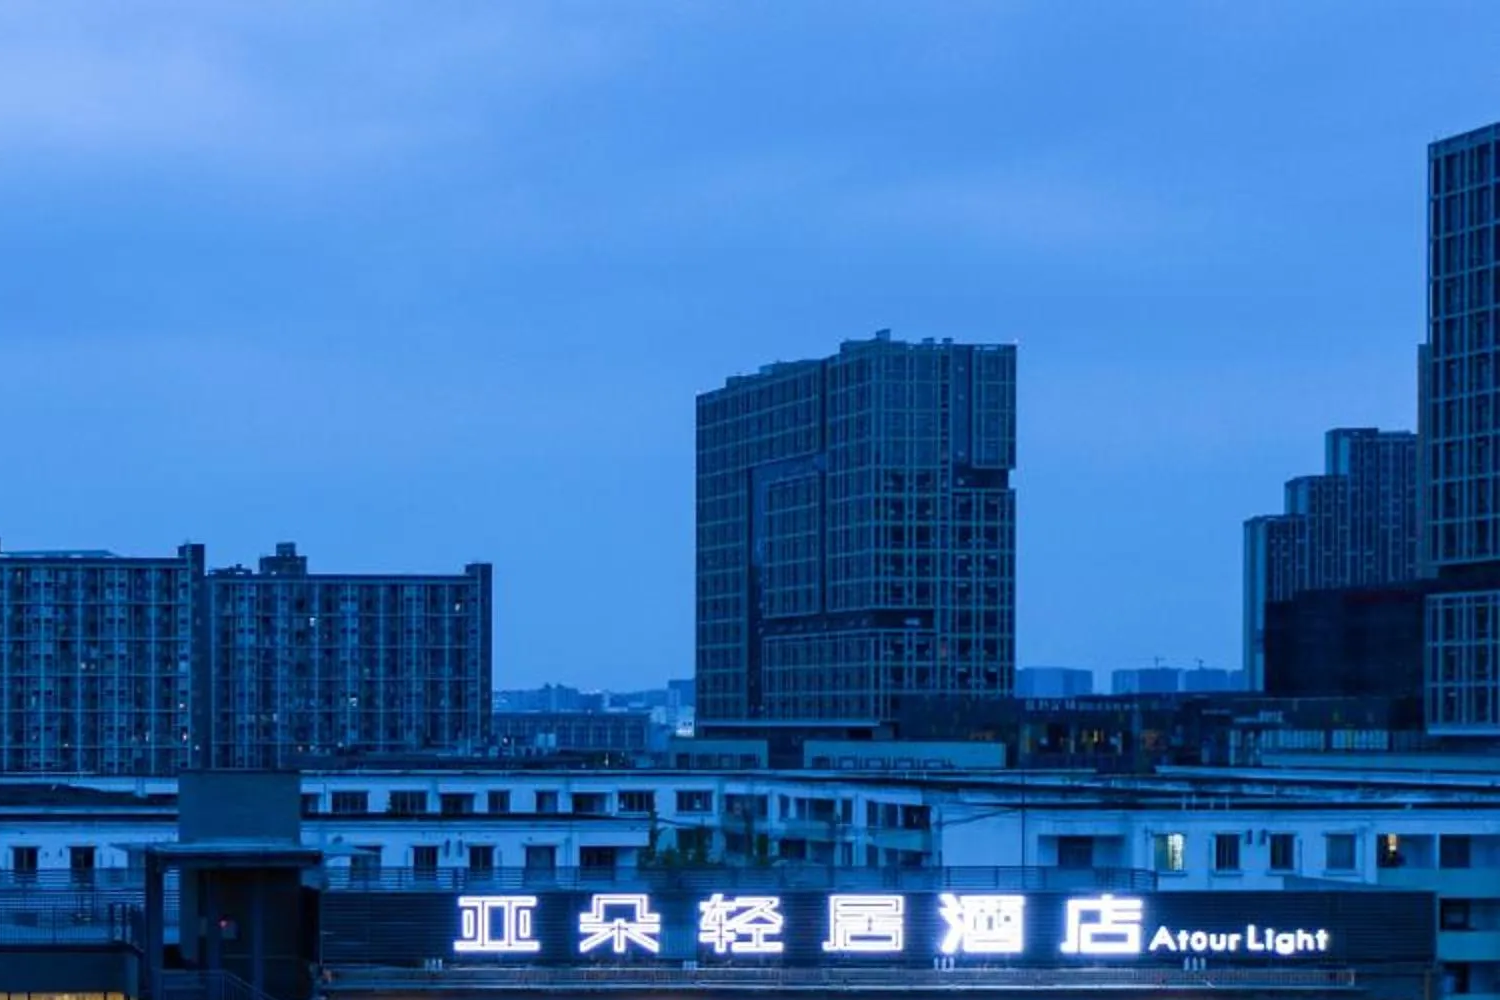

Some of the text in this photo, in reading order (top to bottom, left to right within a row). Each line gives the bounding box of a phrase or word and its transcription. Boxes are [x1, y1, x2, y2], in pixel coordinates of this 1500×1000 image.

[454, 893, 1143, 953] 亚朵轻居酒店
[1149, 905, 1329, 955] Atour Light
